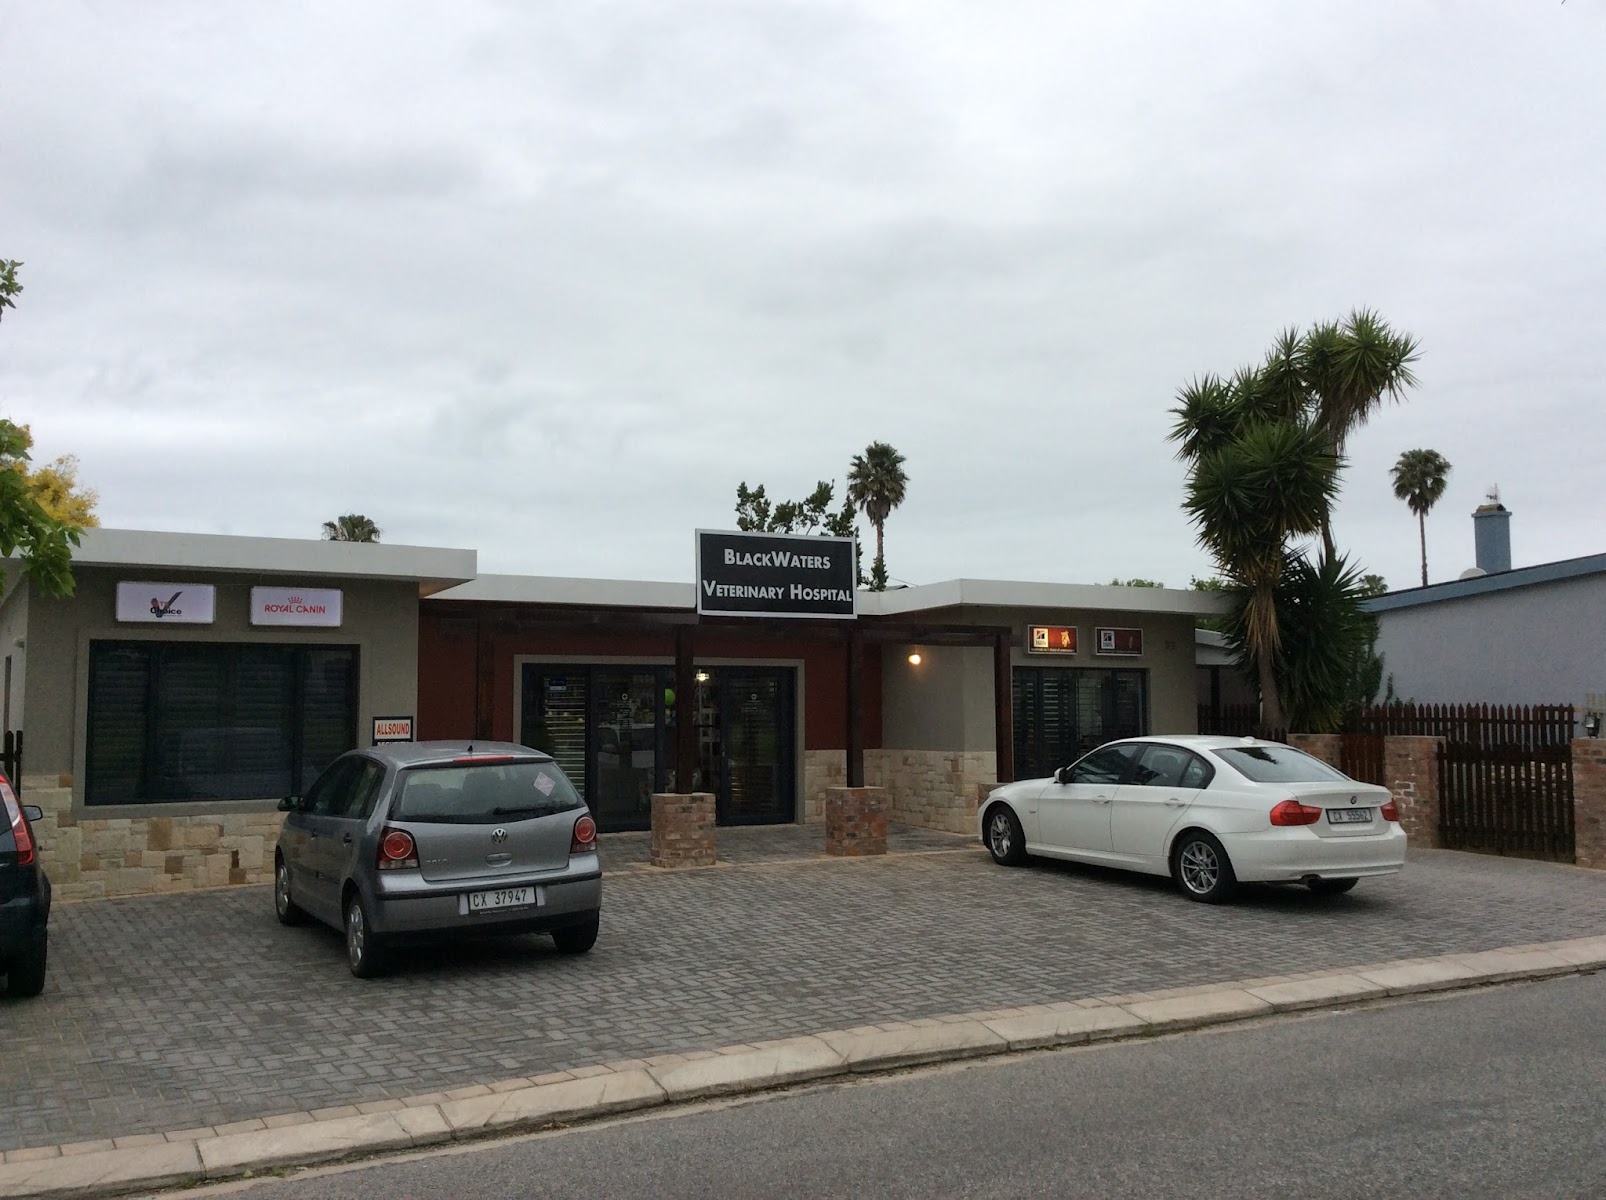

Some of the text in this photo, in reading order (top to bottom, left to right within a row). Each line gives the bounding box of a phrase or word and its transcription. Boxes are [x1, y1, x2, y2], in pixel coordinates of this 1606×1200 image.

[724, 548, 831, 569] BLACKWATERS
[702, 580, 852, 602] VETERINARY HOSPITAL
[264, 604, 326, 614] ROYAL CANIN
[377, 723, 409, 735] ALLSOUND
[473, 889, 527, 907] CX 37947
